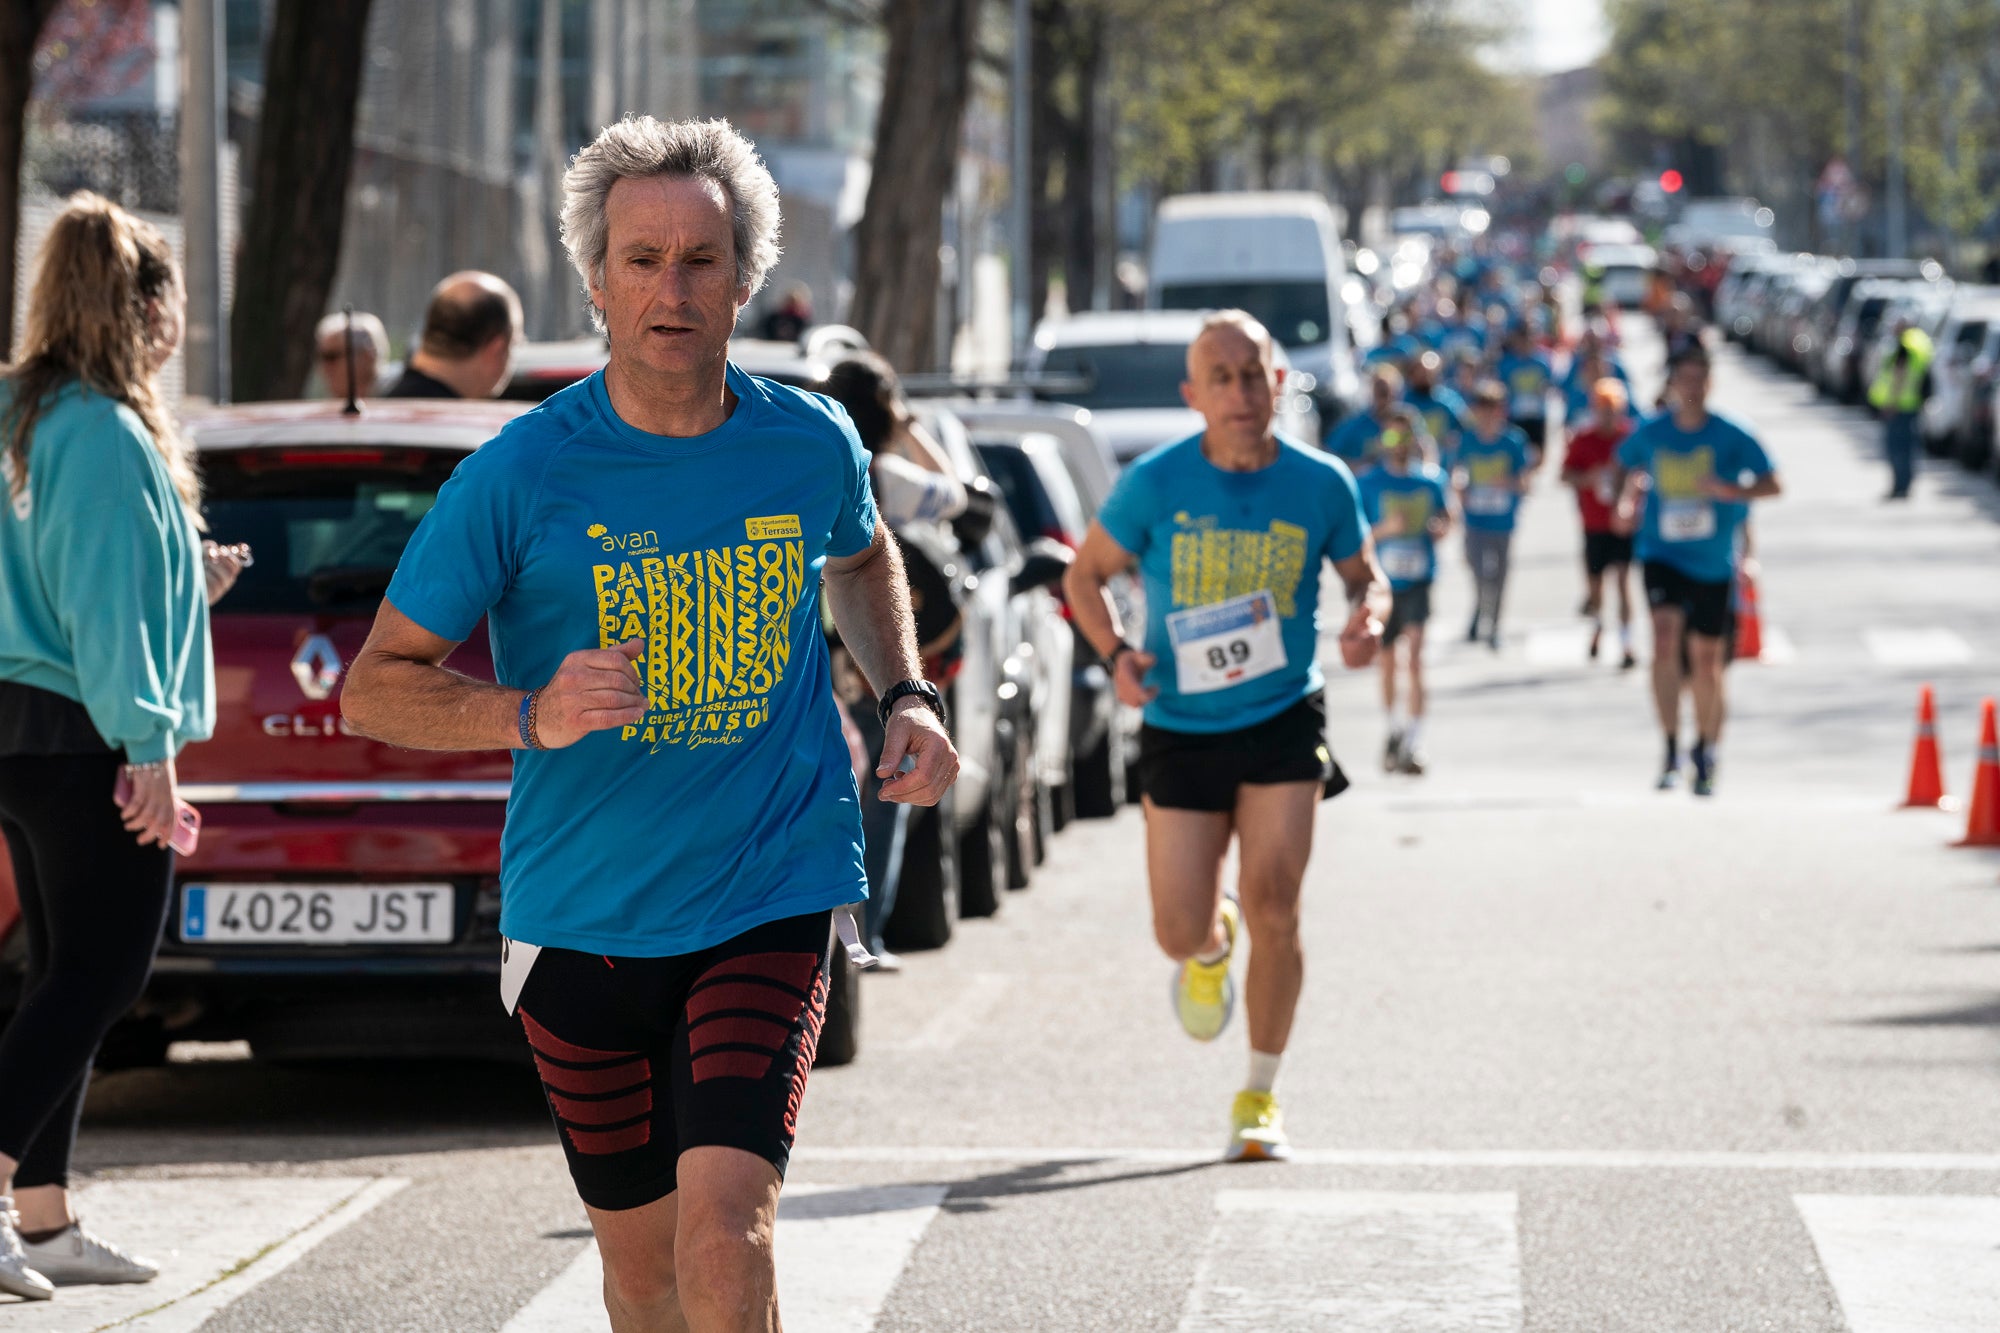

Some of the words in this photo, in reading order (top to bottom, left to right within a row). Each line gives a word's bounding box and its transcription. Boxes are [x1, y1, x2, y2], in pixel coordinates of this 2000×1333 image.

[602, 530, 659, 552] avan
[762, 527, 799, 536] Terrassa
[592, 541, 804, 593] PARKINSON
[1207, 639, 1250, 669] 89
[219, 892, 334, 934] 4026
[354, 891, 438, 934] JST
